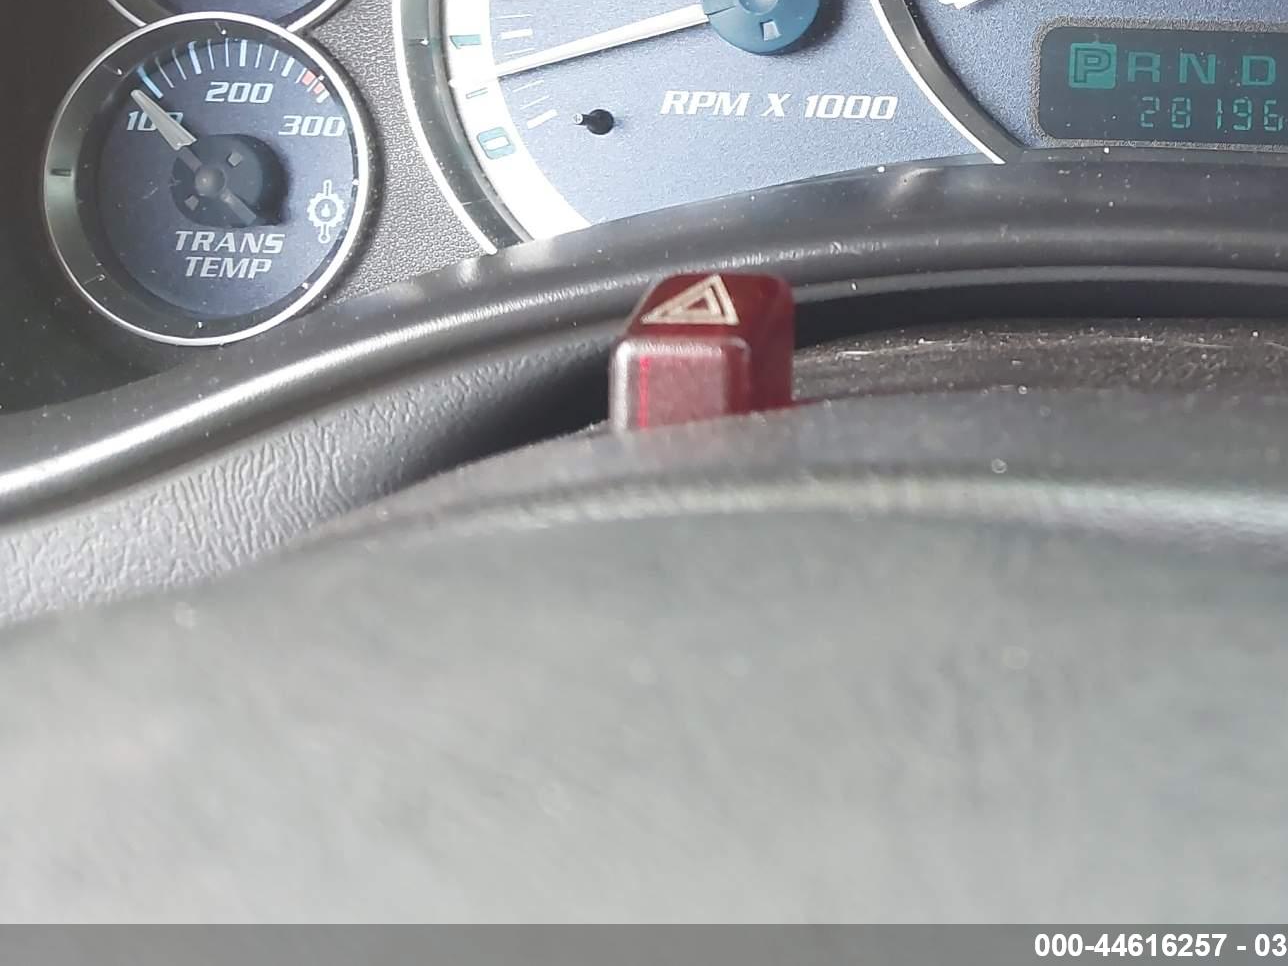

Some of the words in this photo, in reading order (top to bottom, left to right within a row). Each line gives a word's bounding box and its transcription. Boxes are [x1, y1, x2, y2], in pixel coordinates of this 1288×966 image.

[450, 34, 483, 51] 1
[1074, 48, 1112, 84] P
[1127, 52, 1161, 84] R
[1178, 52, 1216, 85] N
[1241, 56, 1277, 86] D
[205, 81, 272, 105] 200
[659, 90, 750, 117] RPM
[760, 93, 791, 117] X
[803, 94, 898, 120] 1000
[278, 114, 346, 139] 300
[476, 126, 516, 160] 0
[174, 230, 286, 256] TRANS
[184, 255, 272, 280] TEMP
